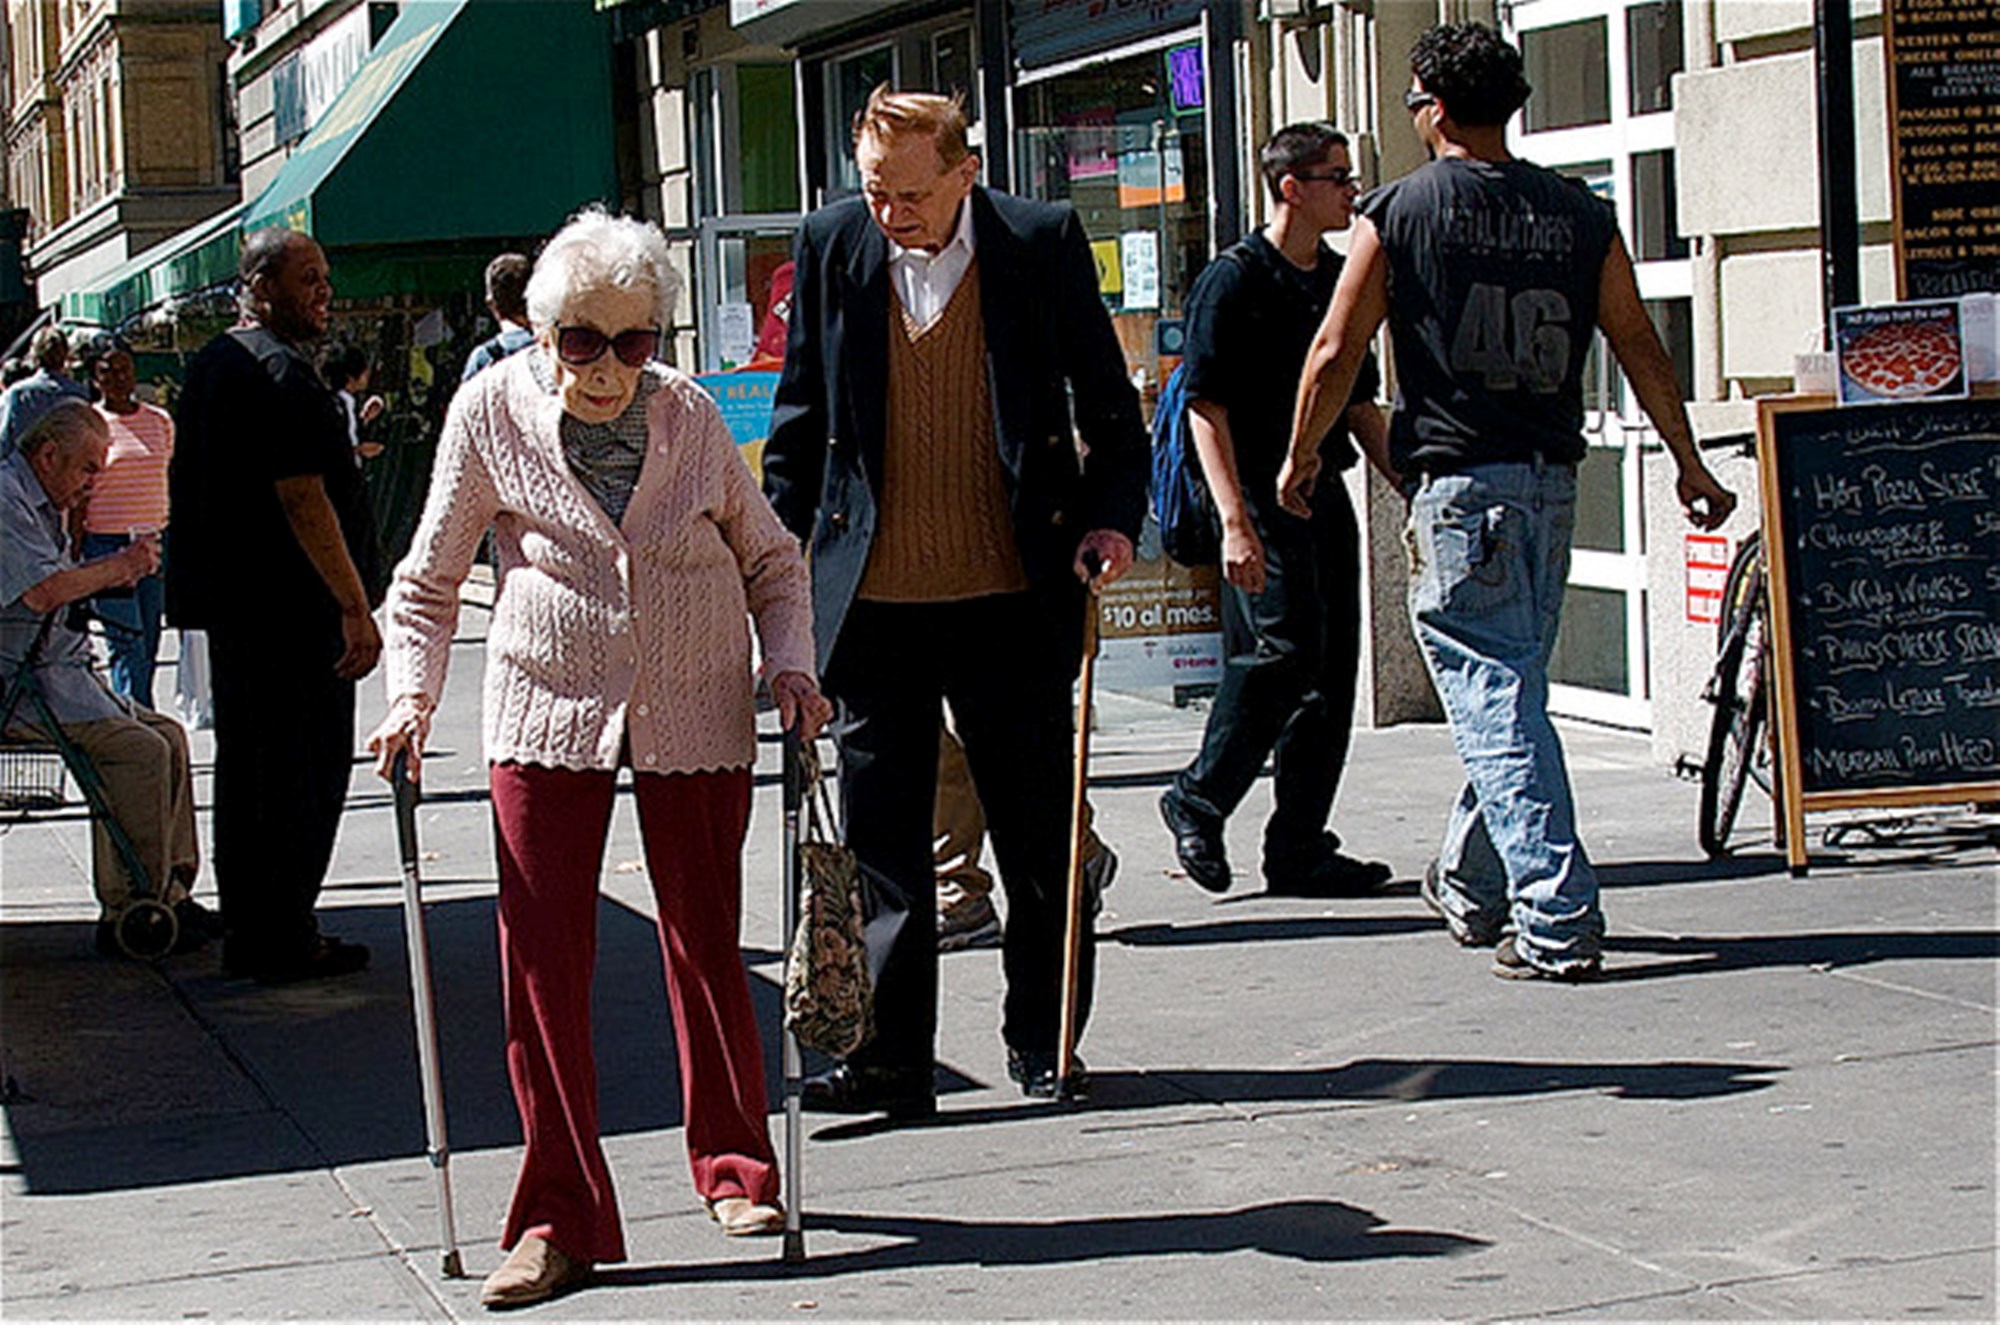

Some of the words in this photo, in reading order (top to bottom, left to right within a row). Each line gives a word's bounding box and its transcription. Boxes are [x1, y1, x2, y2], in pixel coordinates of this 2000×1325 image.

[1911, 144, 1946, 158] EGGS
[1932, 206, 1964, 221] SIDE
[1904, 226, 1950, 240] BACON
[1956, 224, 1977, 238] OR
[1450, 280, 1572, 395] 46
[1103, 604, 1136, 628] $10
[1140, 603, 1162, 626] al
[1166, 604, 1219, 626] mes.
